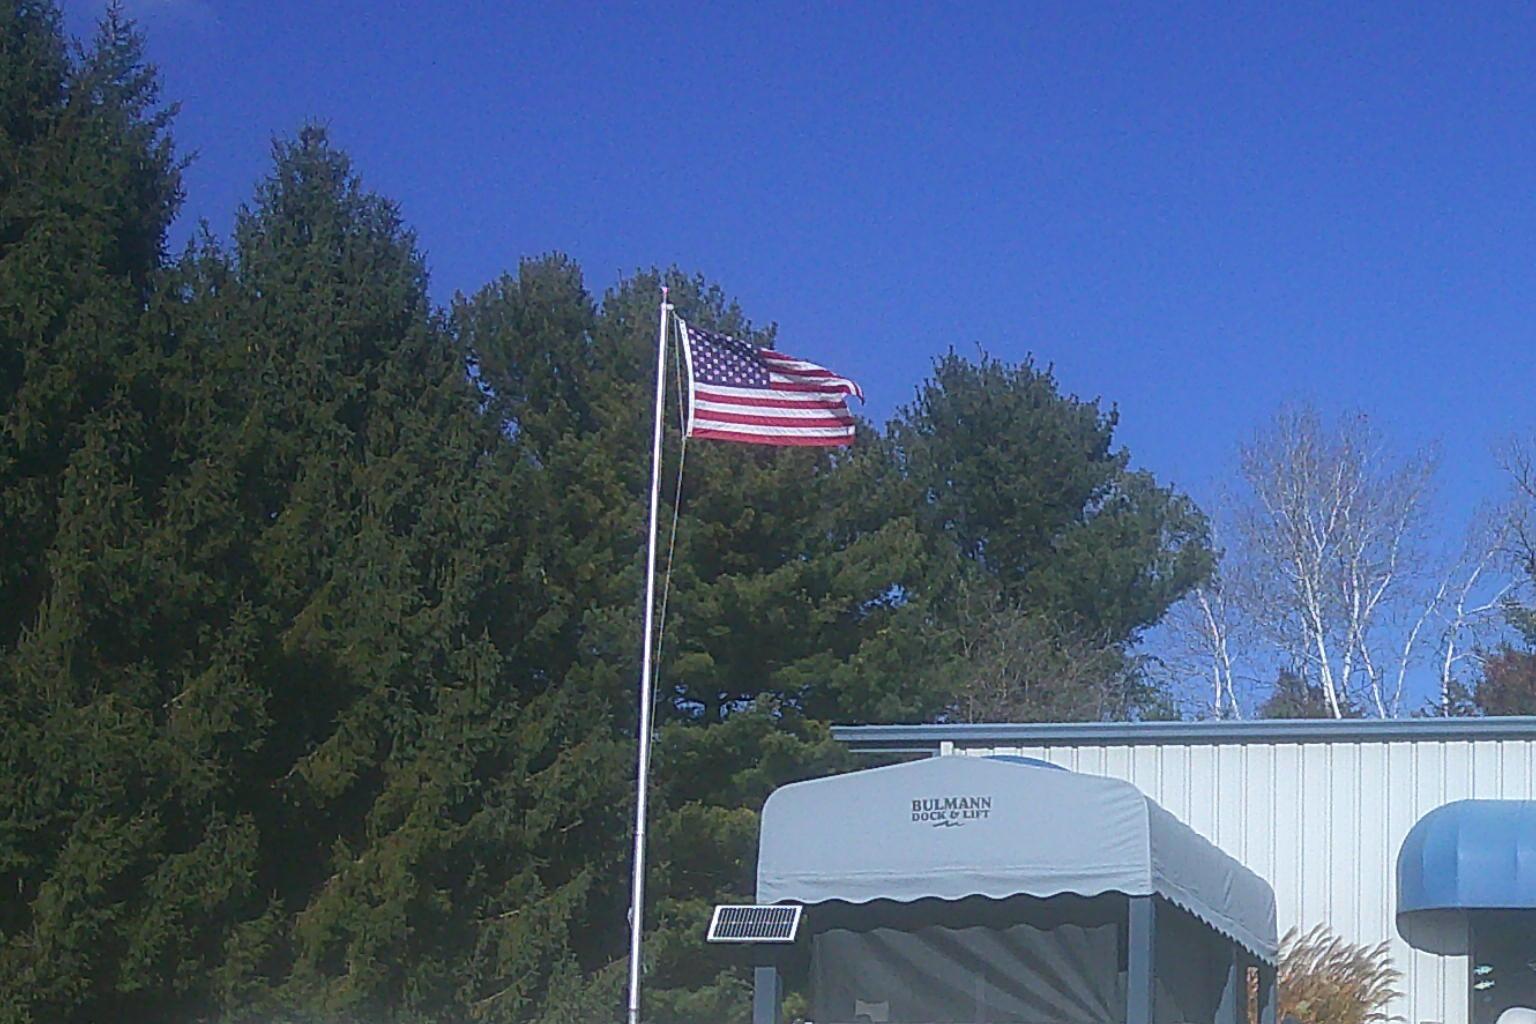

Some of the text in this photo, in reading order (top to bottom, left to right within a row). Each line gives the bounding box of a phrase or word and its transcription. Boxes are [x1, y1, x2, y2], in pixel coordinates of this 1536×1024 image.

[912, 797, 991, 811] BULMANN
[911, 809, 989, 821] DOCK & LIFT
